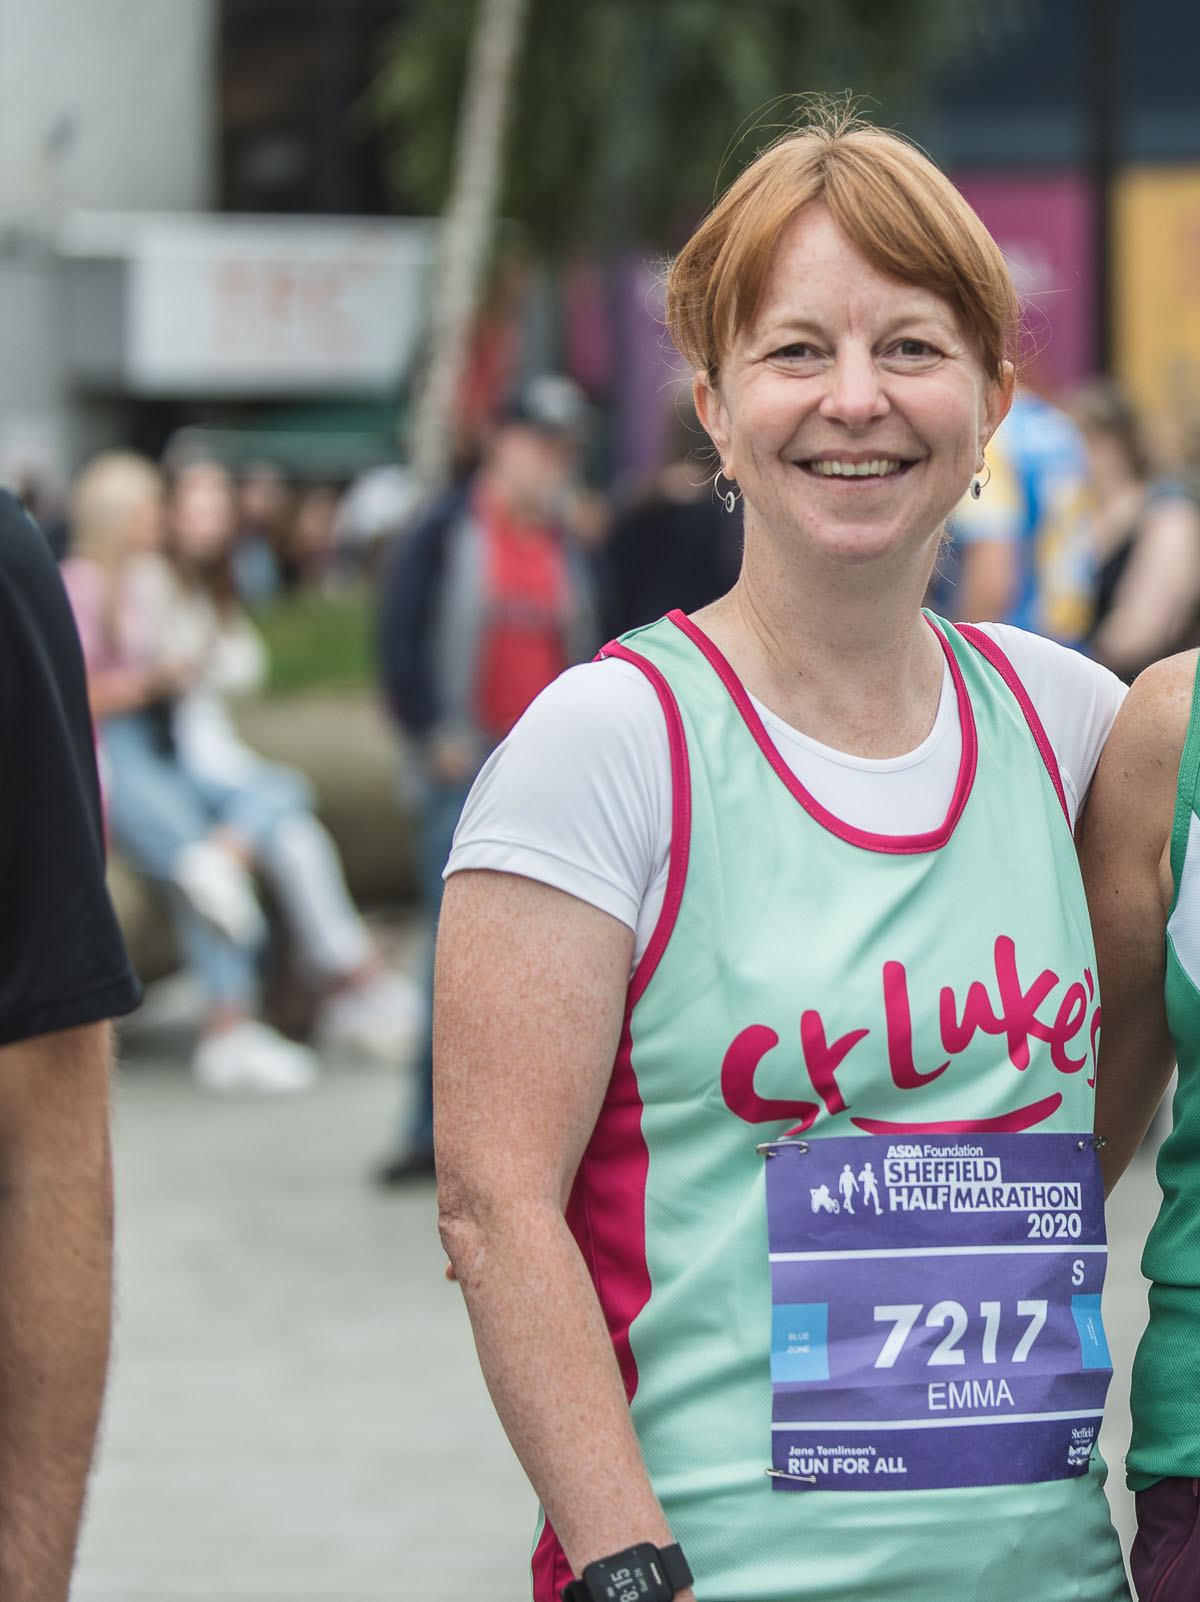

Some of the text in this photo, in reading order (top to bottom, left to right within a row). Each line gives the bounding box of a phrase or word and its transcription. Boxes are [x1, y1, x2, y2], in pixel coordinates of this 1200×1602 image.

[886, 1144, 984, 1158] ASDA Foundation
[888, 1159, 998, 1184] SHEFFIELD
[889, 1185, 1080, 1212] HALF MARATHON
[1027, 1213, 1082, 1238] 2020
[1071, 1260, 1085, 1286] S
[787, 1332, 810, 1341] BLUE
[873, 1299, 1049, 1369] 7217
[786, 1344, 810, 1354] ZONE
[928, 1378, 1016, 1411] EMMA
[1071, 1426, 1094, 1440] Sheffield
[788, 1445, 877, 1456] Jane Tomlinson's
[788, 1456, 907, 1474] RUN FOR ALL
[610, 1567, 639, 1602] 8:15
